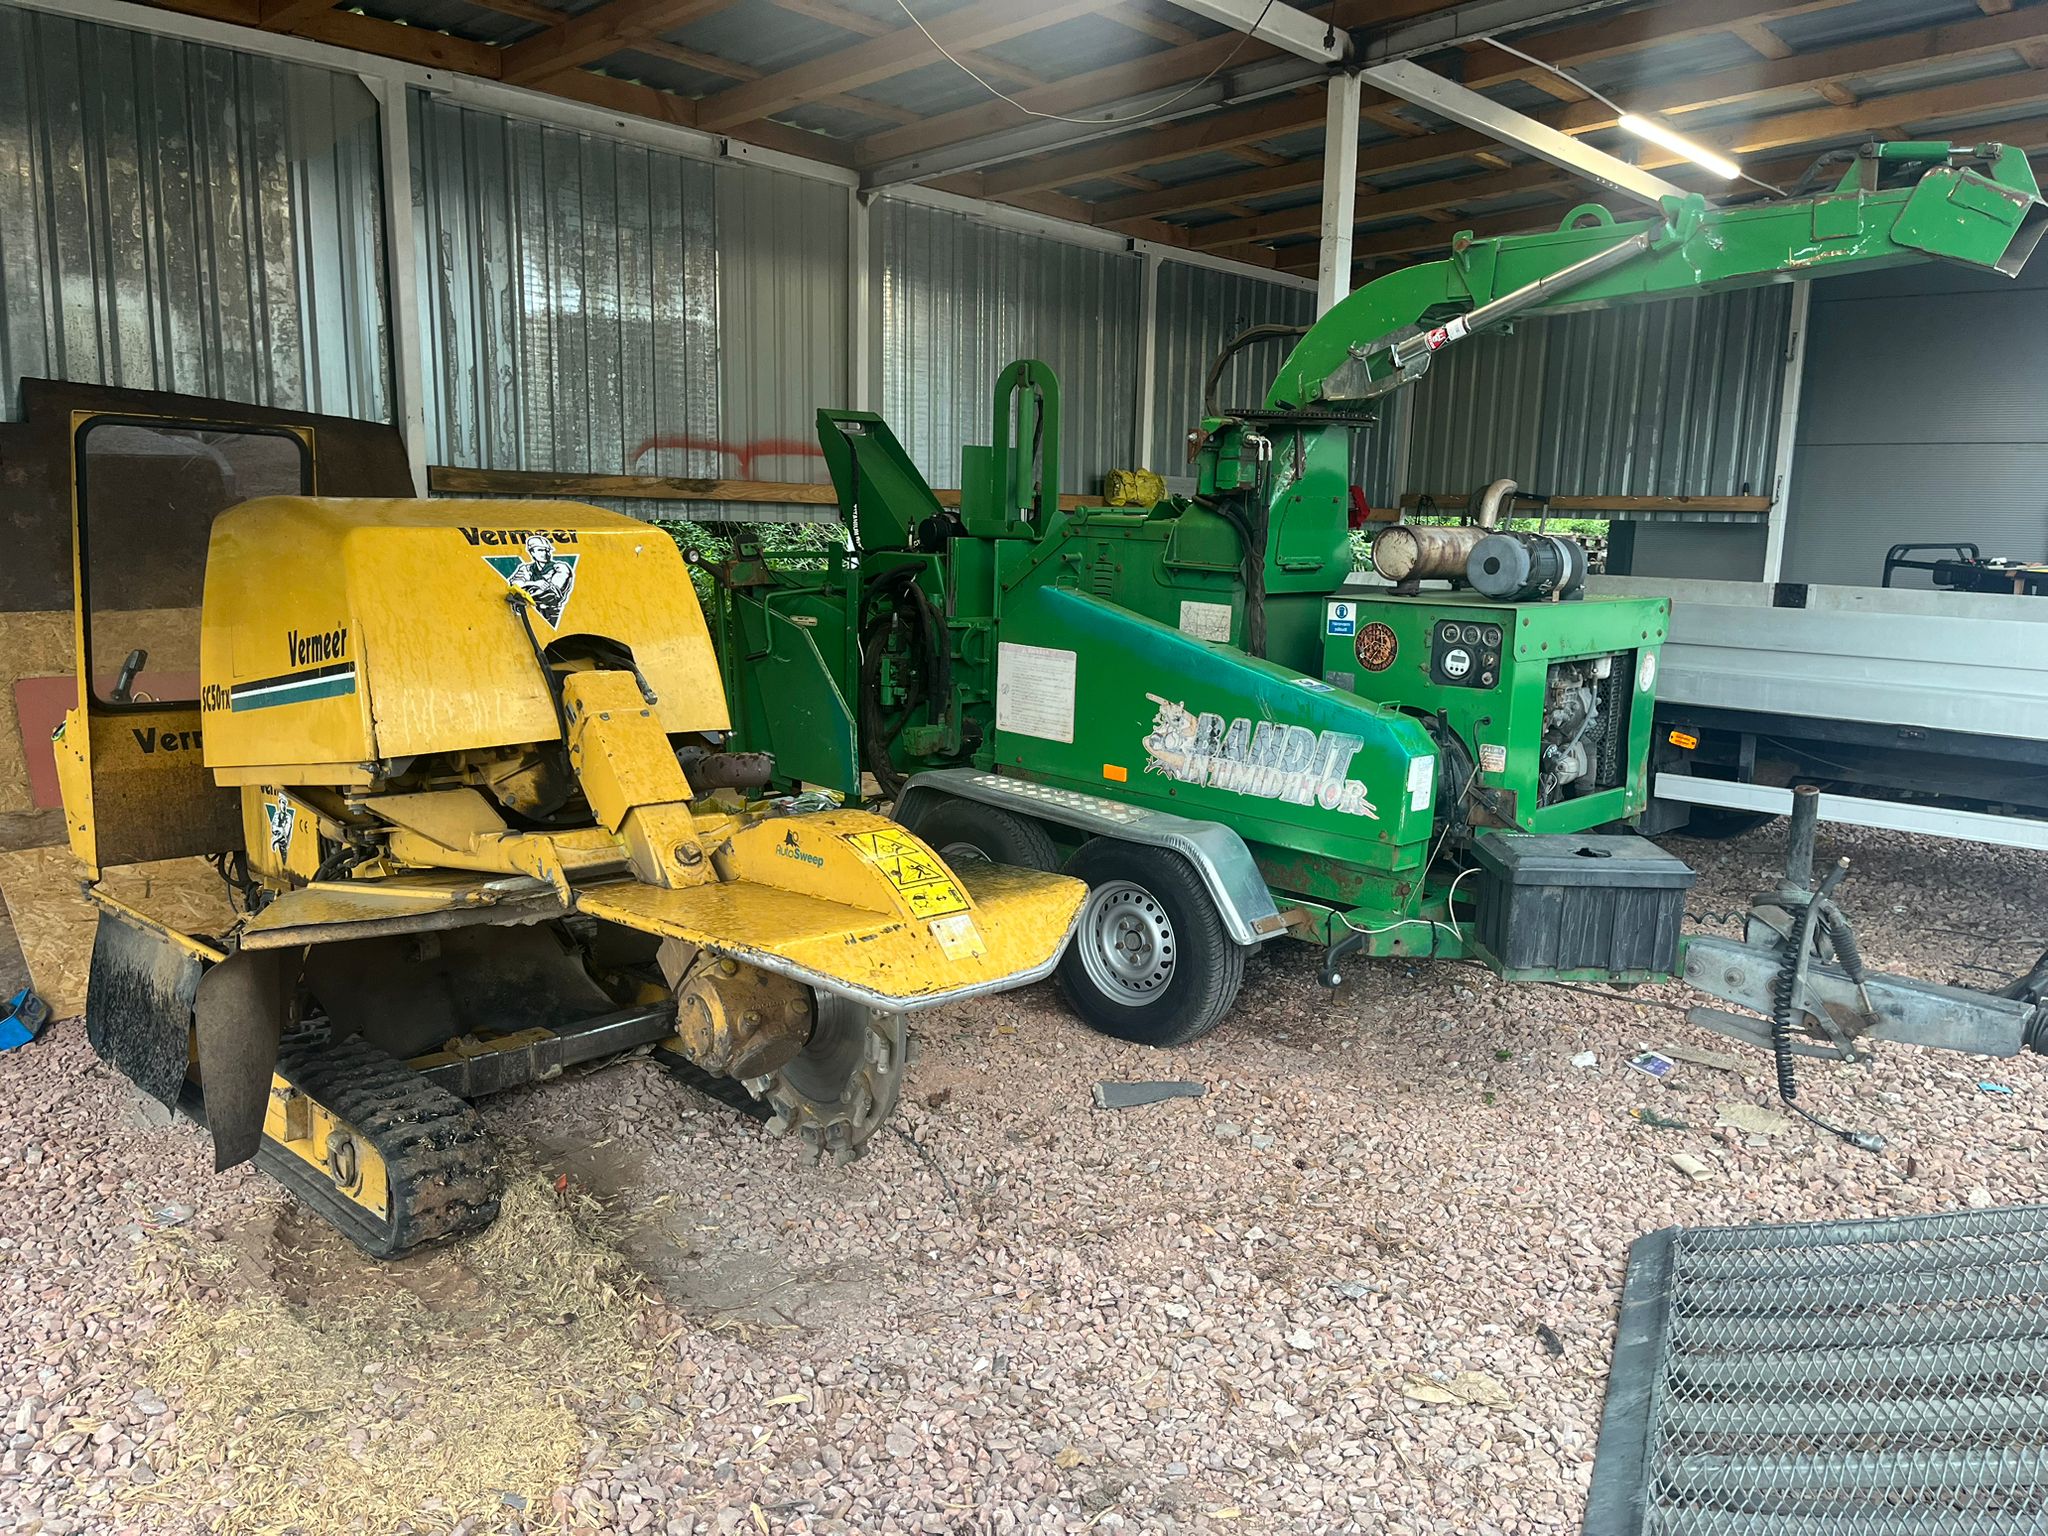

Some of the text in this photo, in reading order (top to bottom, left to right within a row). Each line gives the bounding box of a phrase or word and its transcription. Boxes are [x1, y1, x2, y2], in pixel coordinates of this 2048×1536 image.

[457, 527, 579, 546] Vermeer
[287, 627, 347, 667] Vermeer
[1192, 712, 1364, 780] BANDIT
[1182, 752, 1380, 820] INTIMIDATOR
[775, 844, 824, 868] AutoSweep
